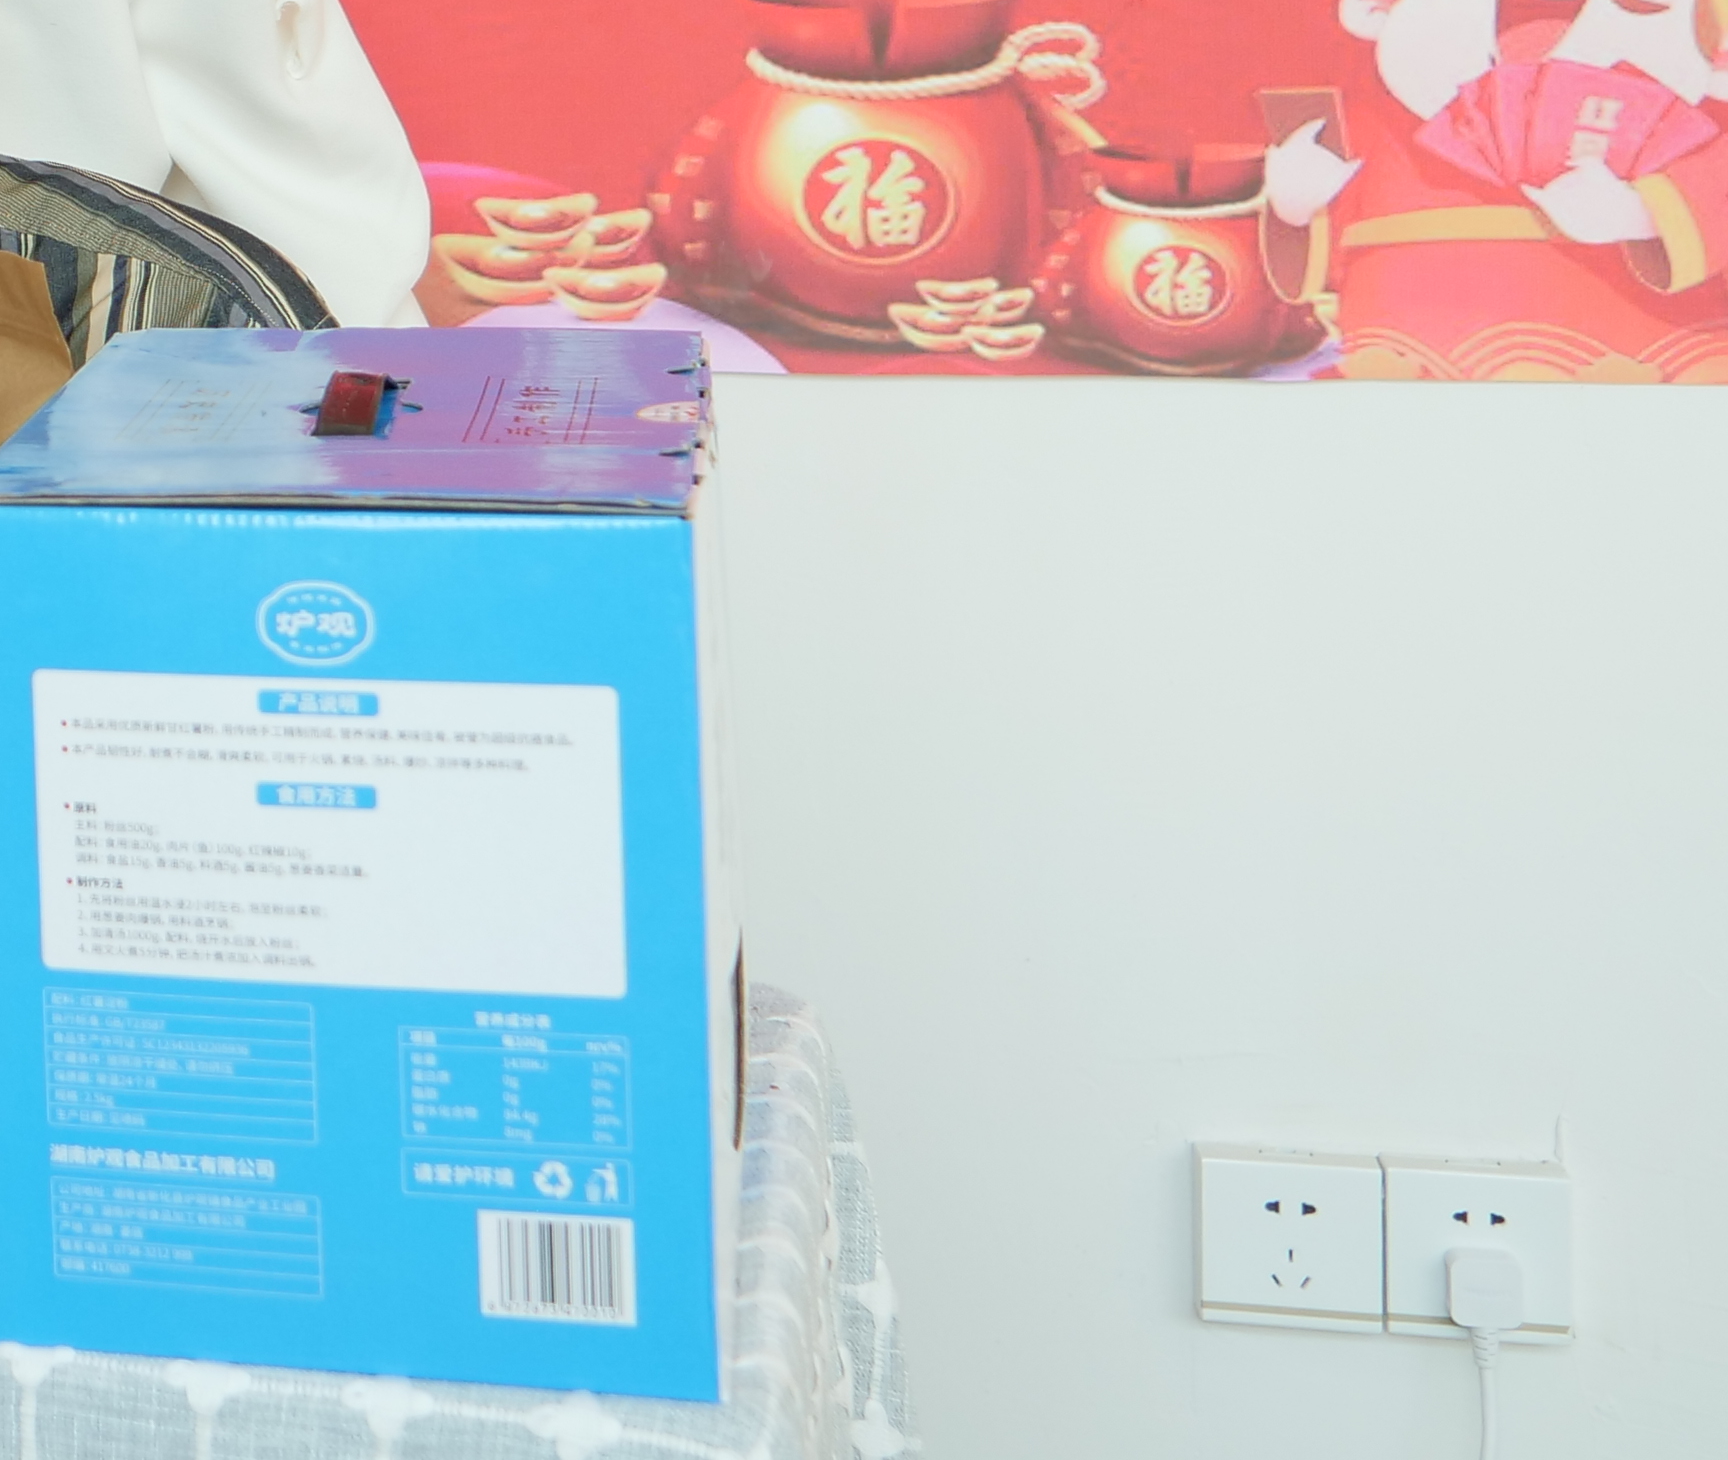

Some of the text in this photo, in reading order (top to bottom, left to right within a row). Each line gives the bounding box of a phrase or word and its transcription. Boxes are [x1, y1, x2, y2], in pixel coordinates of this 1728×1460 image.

[819, 144, 925, 252] 福
[1142, 244, 1216, 322] 福
[275, 609, 357, 638] 炉观
[277, 692, 361, 715] 产品说明
[276, 785, 358, 808] 食用方法
[49, 1142, 275, 1180] 湖南炉观食品加工有限公司
